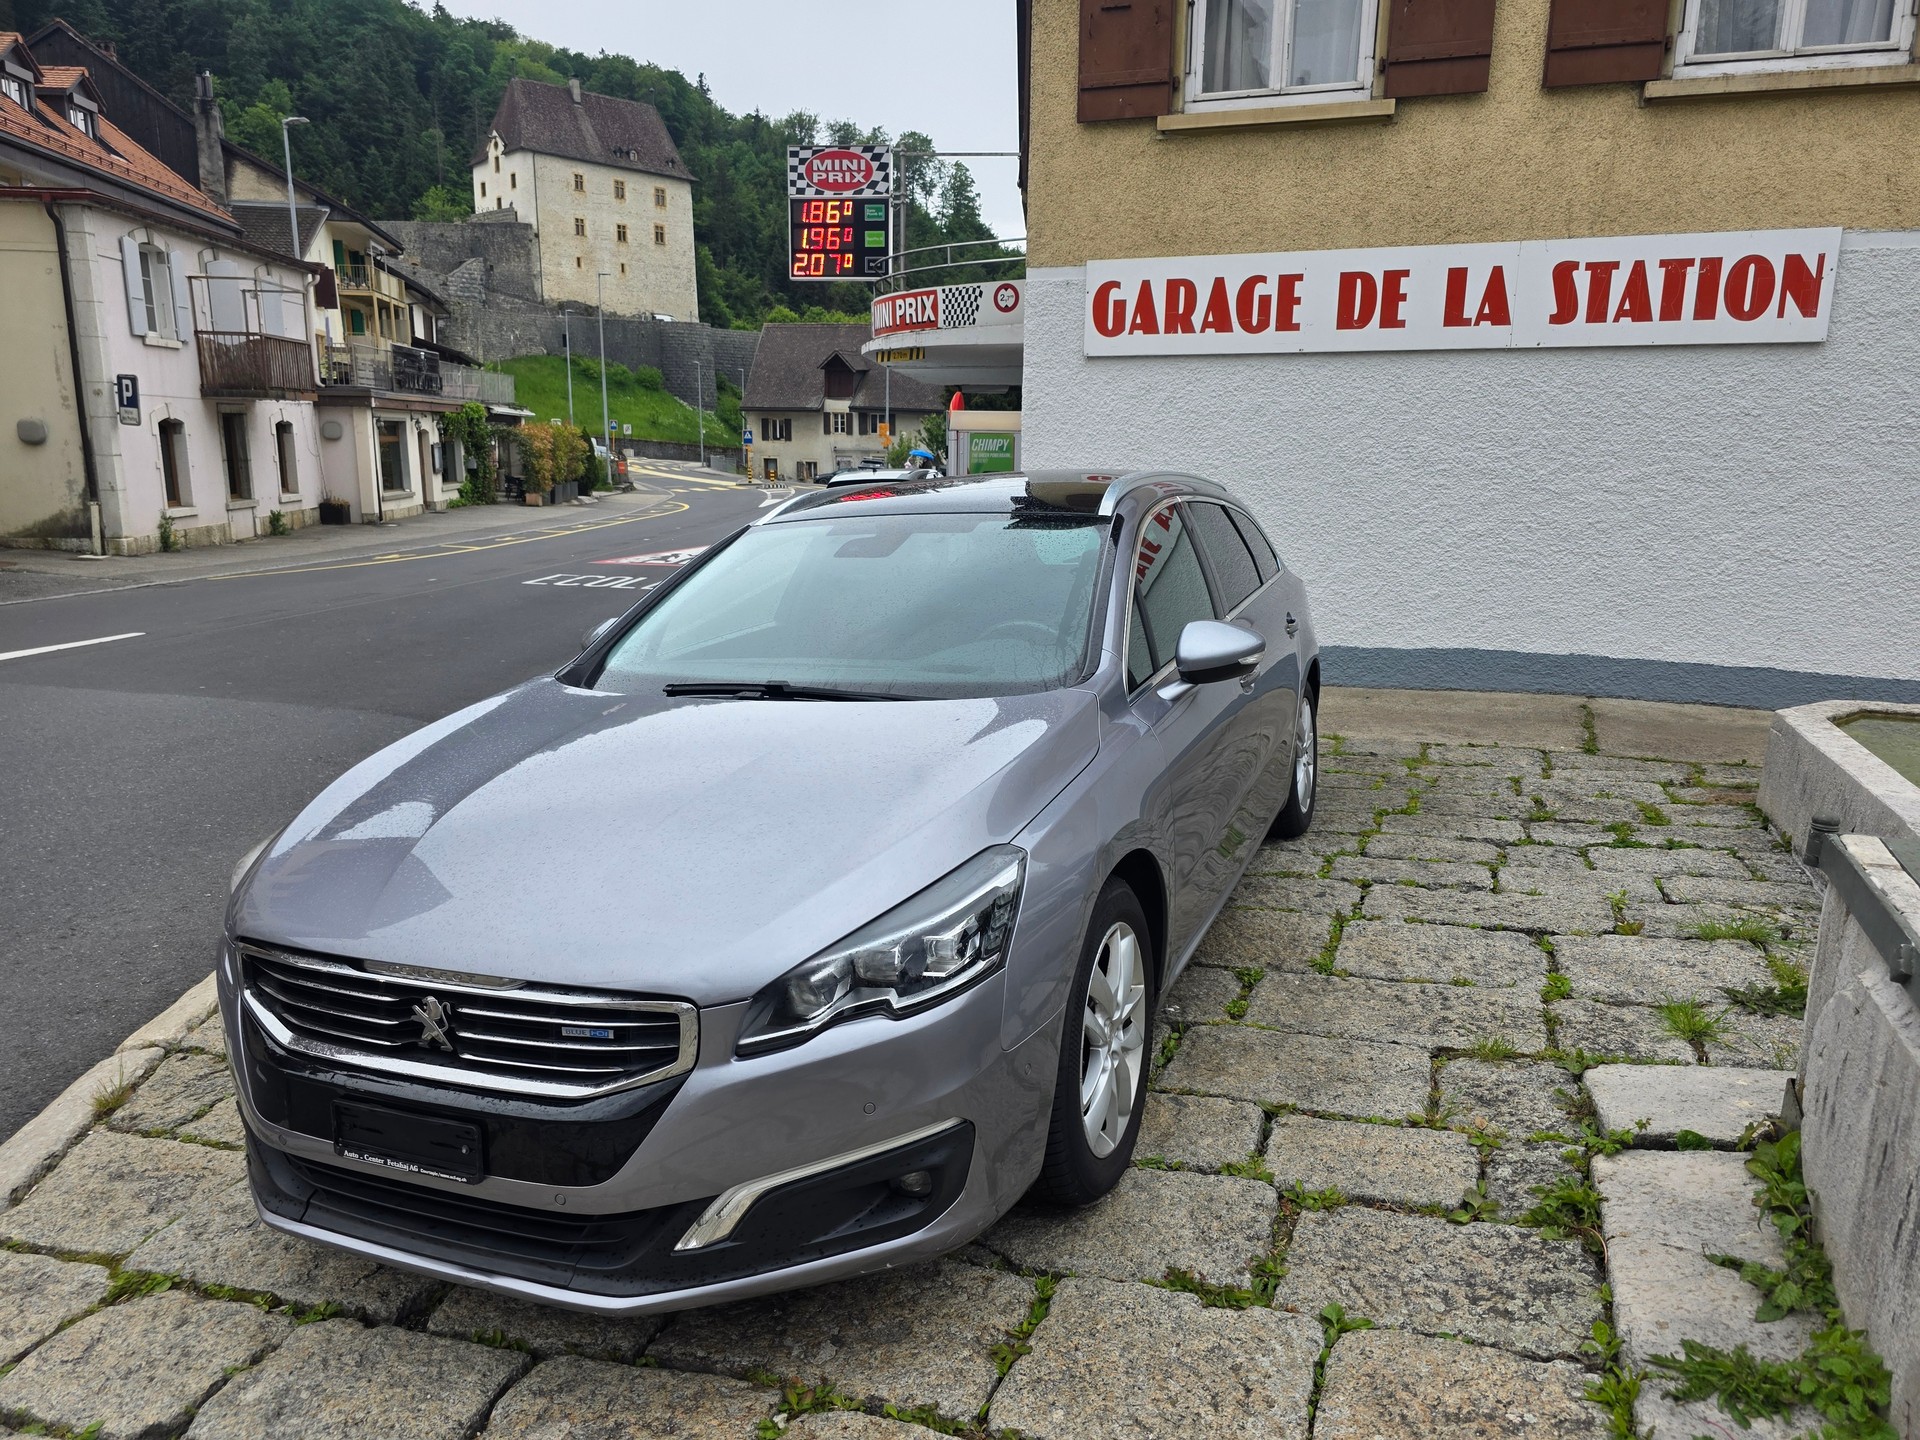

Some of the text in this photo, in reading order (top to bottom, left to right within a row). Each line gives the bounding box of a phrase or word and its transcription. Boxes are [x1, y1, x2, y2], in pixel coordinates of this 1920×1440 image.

[812, 159, 866, 171] MINI
[812, 171, 867, 184] PRIX
[1092, 253, 1826, 338] GARAGE DE LA STATION
[874, 294, 936, 330] MINI PRIX
[122, 379, 133, 405] P
[972, 438, 1010, 451] CHIMPY
[343, 1150, 359, 1159] Auto
[364, 1154, 384, 1164] Center
